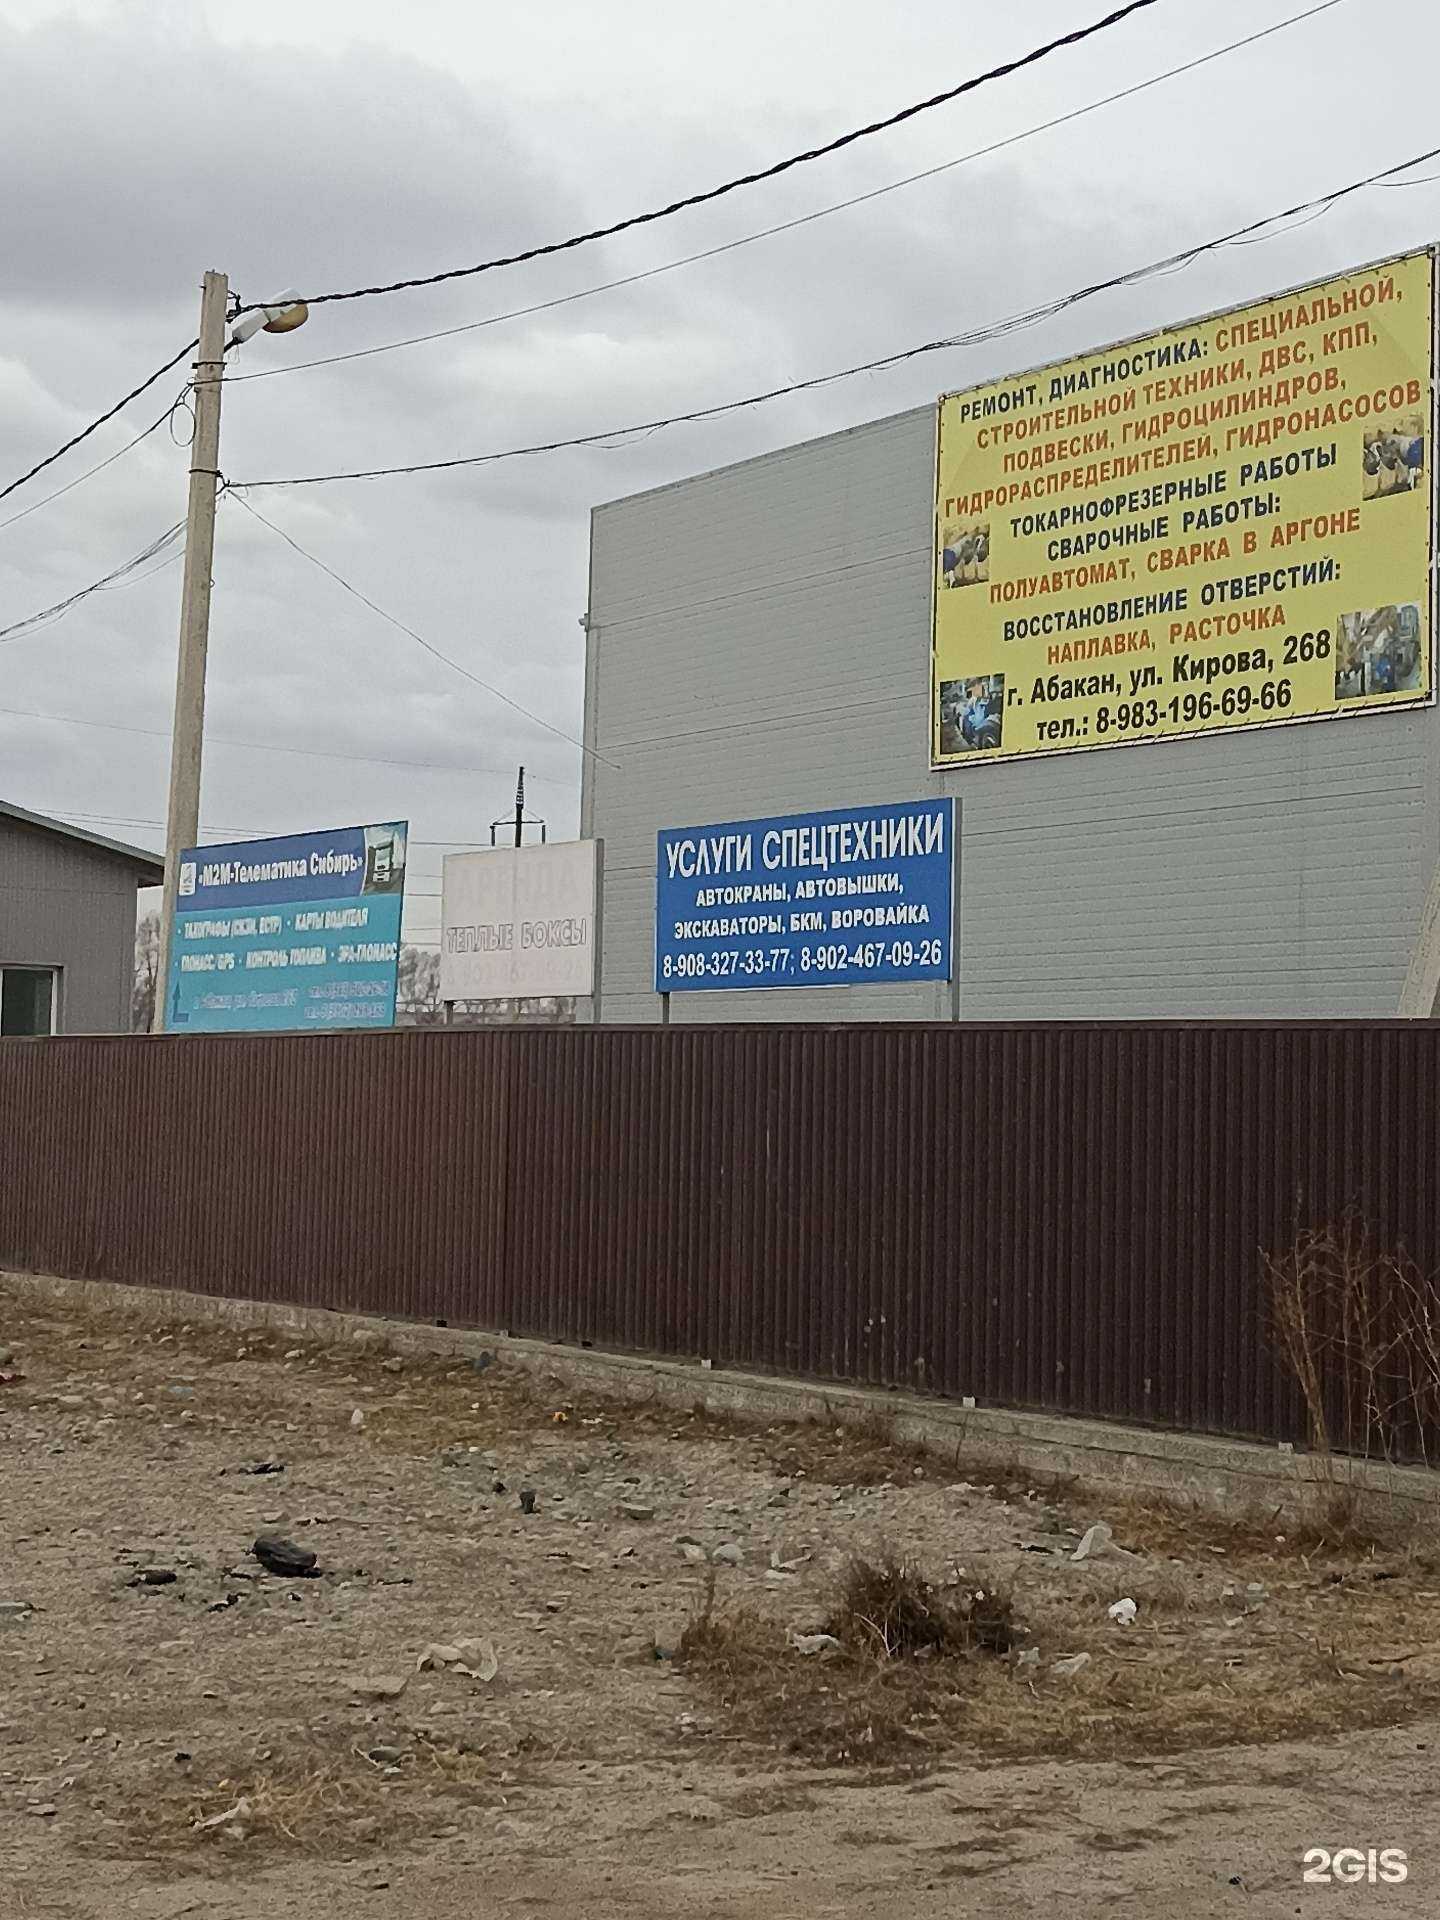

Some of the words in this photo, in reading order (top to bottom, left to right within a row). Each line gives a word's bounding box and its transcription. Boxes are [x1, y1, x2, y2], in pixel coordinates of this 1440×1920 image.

[960, 384, 1043, 422] РЕМОНТ,
[1049, 340, 1209, 402] ДИАГНОСТИКА:
[1215, 276, 1403, 351] СПЕЦИАЛЬНОЙ,
[977, 386, 1137, 448] СТРОИТЕЛЬНОЙ
[1142, 359, 1252, 405] ТЕХНИКИ,
[1259, 340, 1315, 376] ДВС,
[1323, 321, 1378, 355] КПП,
[945, 435, 1218, 518] ГИДРОРАСПРЕДЕЛИТЕЛЕЙ,
[1225, 381, 1421, 452] ГИДРОНАСОСОВ
[1003, 430, 1115, 473] ПОДВЕСКИ,
[1122, 367, 1347, 443] ГИДРОЦИЛИНДРОВ,
[1010, 470, 1226, 538] ТОКАРНОФРЕЗЕРНЫЕ
[1240, 444, 1338, 486] РАБОТЫ
[1047, 515, 1169, 561] СВАРОЧНЫЕ
[1182, 493, 1282, 533] РАБОТЫ:
[990, 557, 1136, 604] ПОЛУАВТОМАТ,
[1147, 536, 1230, 573] СВАРКА
[1243, 532, 1258, 553] В
[1270, 508, 1361, 549] АРГОНЕ
[1003, 589, 1188, 641] ВОССТАНОВЛЕНИЕ
[1201, 554, 1342, 605] ОТВЕРСТИЙ:
[1007, 687, 1023, 707] г.
[1030, 668, 1123, 706] Абакан,
[1129, 662, 1164, 691] ул.
[1172, 644, 1274, 683] Кирова,
[1284, 629, 1331, 664] 268
[1047, 628, 1156, 665] НАПЛАВКА,
[1169, 605, 1286, 643] РАСТОЧКА
[1036, 708, 1090, 741] тел.:
[1096, 679, 1292, 734] 8-983-196-69-66
[666, 834, 751, 878] УСЛУГИ
[763, 812, 944, 871] СПЕЦТЕХНИКИ
[675, 914, 786, 939] ЭКСКАВАТОРЫ,
[790, 912, 827, 932] БКМ,
[831, 903, 929, 929] ВОРОВАЙКА
[696, 883, 791, 906] АВТОКРАНЫ,
[795, 873, 903, 900] АВТОВЫШКИ,
[447, 924, 513, 953] ТЕПЛЫЕ
[521, 918, 586, 949] БОКСЫ
[800, 939, 942, 971] 8-902-467-09-26
